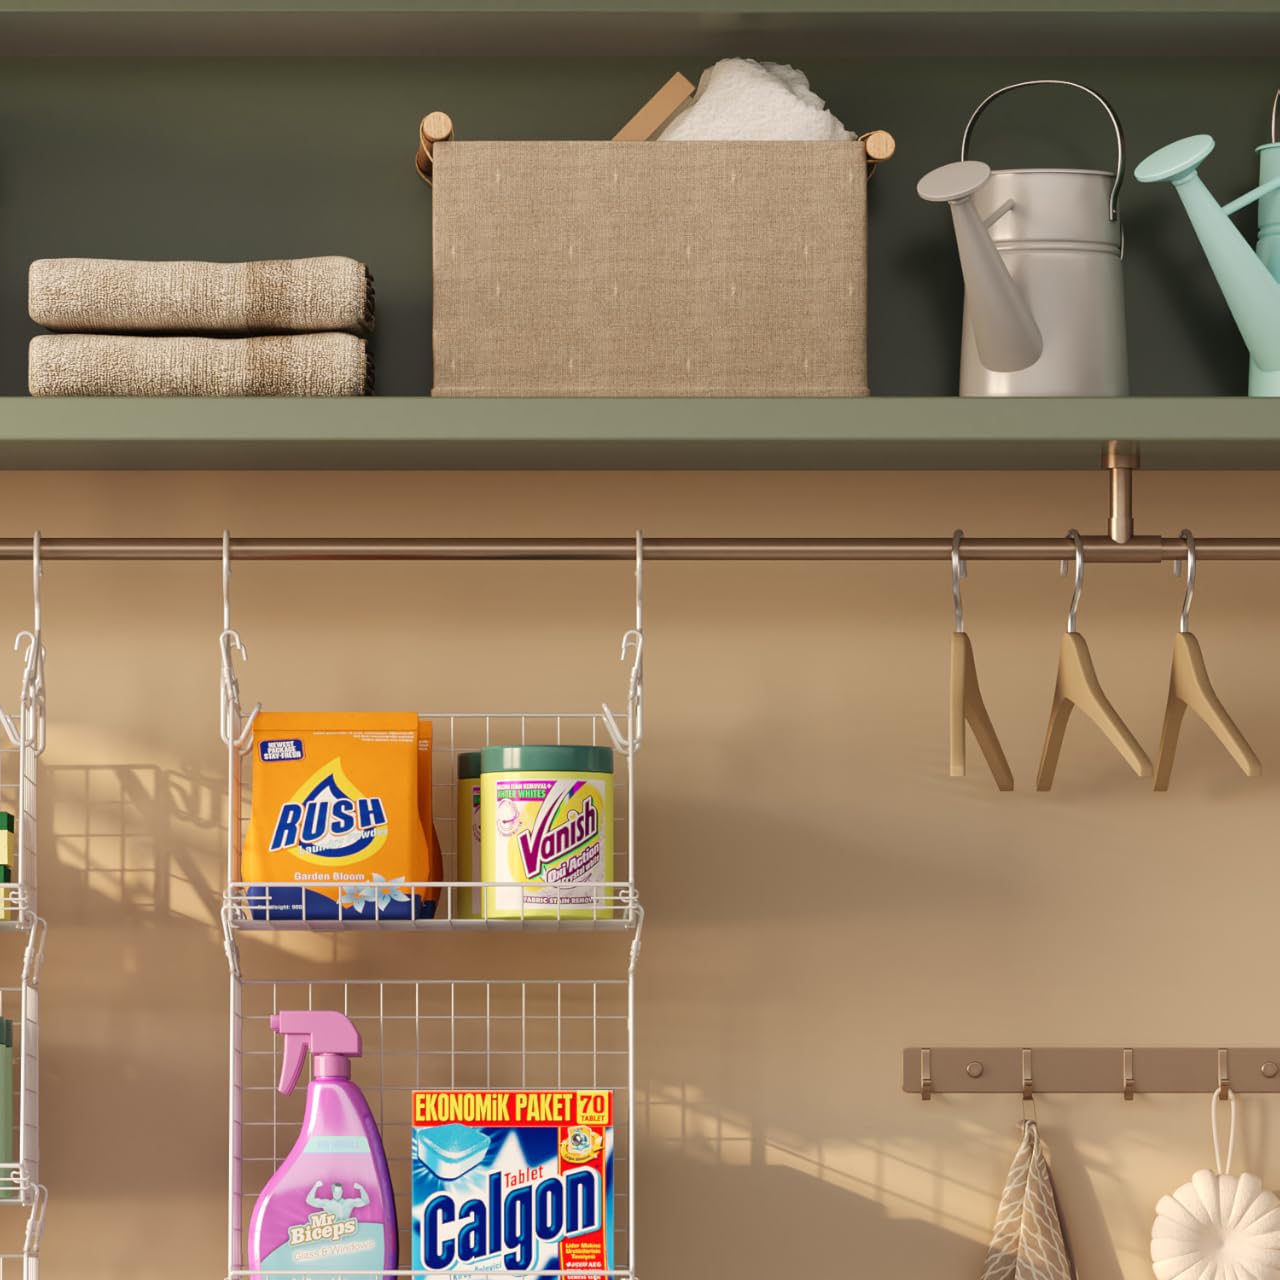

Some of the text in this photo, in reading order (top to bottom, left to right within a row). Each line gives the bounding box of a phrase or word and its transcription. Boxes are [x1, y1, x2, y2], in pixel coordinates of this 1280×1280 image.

[270, 798, 386, 851] RUSH
[519, 794, 596, 874] Vanish
[569, 843, 600, 871] Action
[294, 872, 364, 881] Garden Bloom
[515, 1094, 573, 1121] PAKET
[581, 1095, 605, 1114] 70
[504, 1166, 544, 1187] Tablet
[290, 1220, 356, 1245] Biceps
[312, 1213, 335, 1229] Mr
[424, 1171, 595, 1271] Calgon
